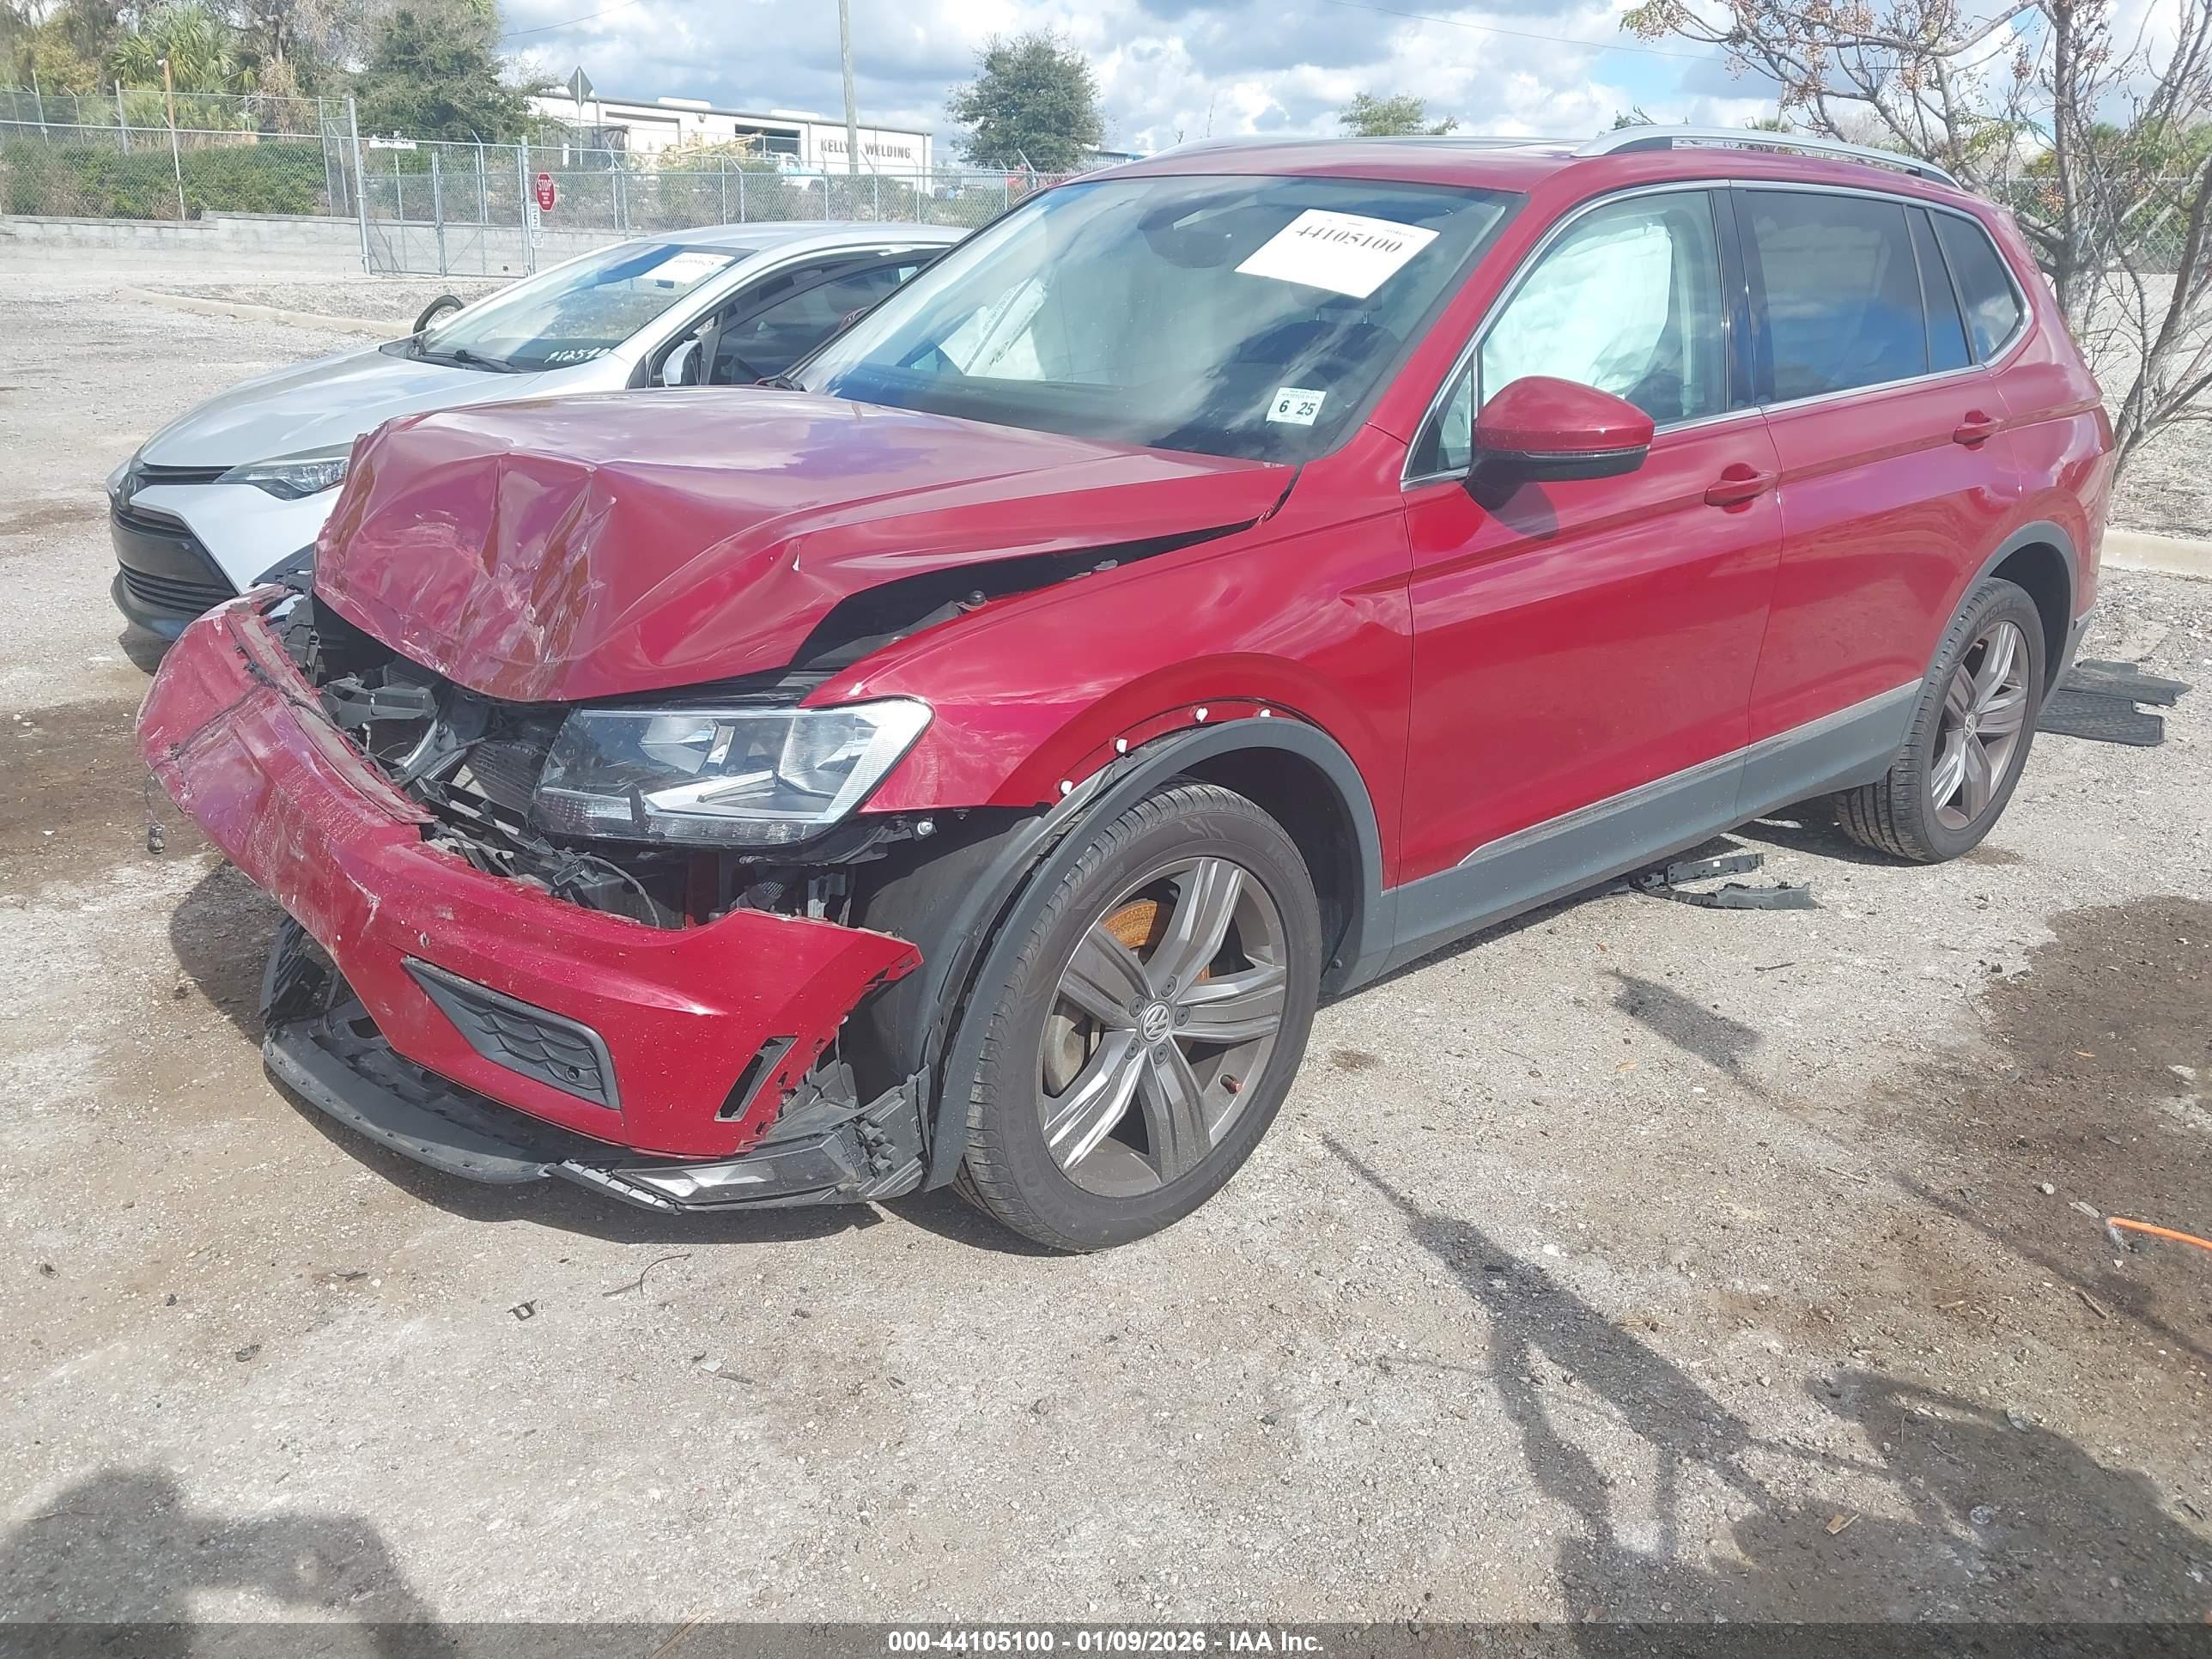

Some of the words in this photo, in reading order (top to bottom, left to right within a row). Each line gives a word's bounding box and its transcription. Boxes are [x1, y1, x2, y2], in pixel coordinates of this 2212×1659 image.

[864, 142, 911, 159] WELDING
[538, 179, 551, 191] STOP
[532, 214, 538, 224] 5
[1295, 225, 1403, 253] 44105100
[1279, 399, 1290, 413] 6
[1296, 401, 1316, 416] 25
